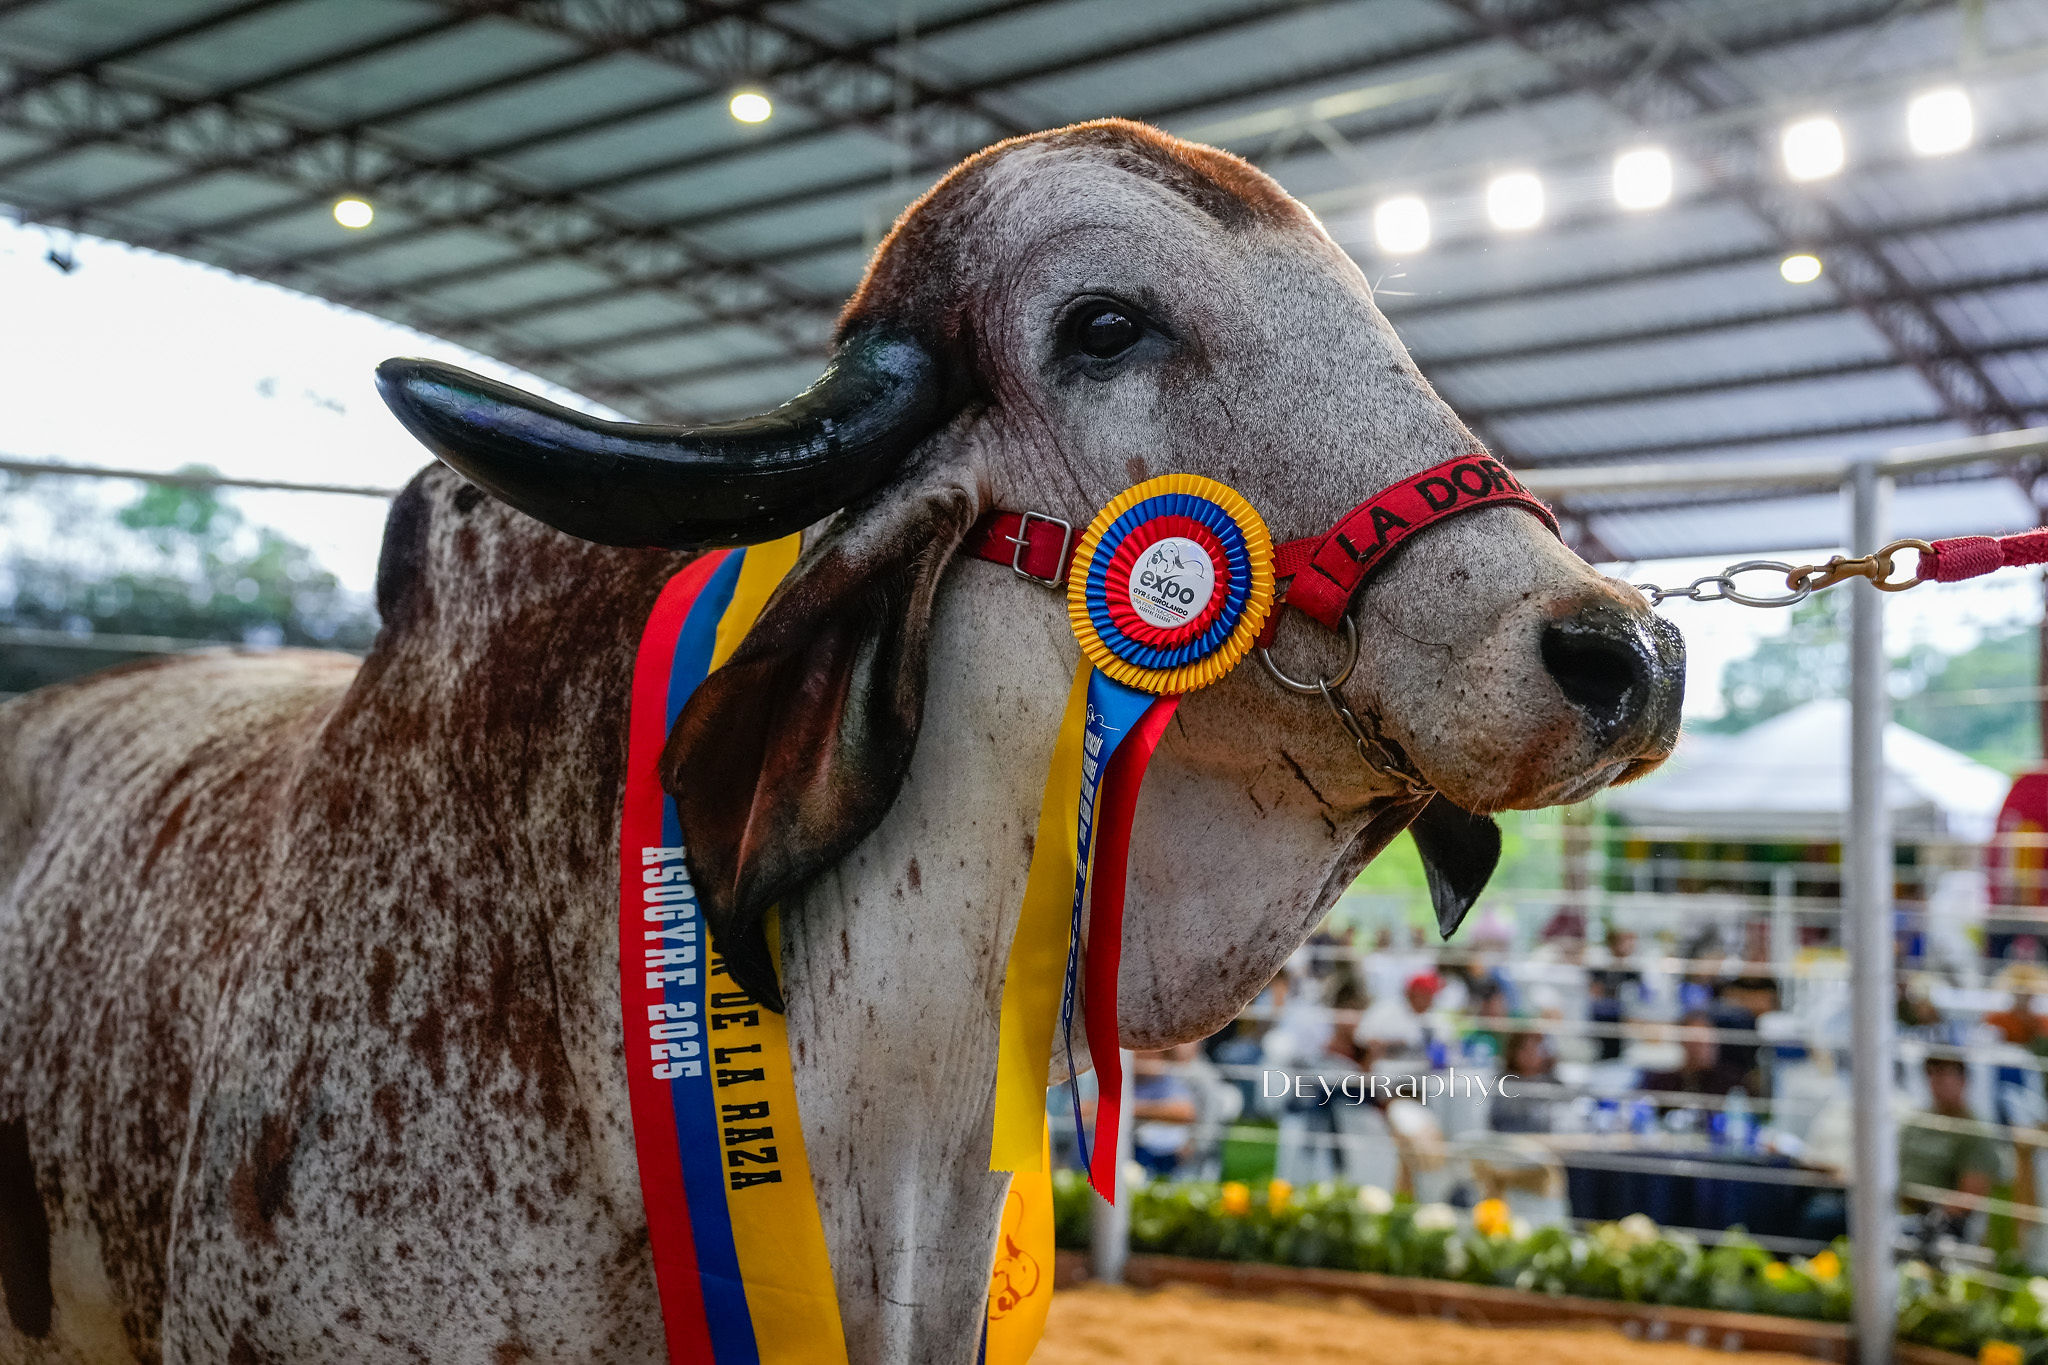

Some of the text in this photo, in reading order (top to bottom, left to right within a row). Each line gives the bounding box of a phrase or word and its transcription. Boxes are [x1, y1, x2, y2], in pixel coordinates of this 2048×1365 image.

[1335, 460, 1524, 565] LA DOR
[1133, 587, 1147, 598] GYR
[1151, 595, 1188, 616] GIROLANDO
[1140, 570, 1195, 605] expo
[642, 846, 703, 1080] ASOGYRE 2025
[710, 991, 783, 1191] DE LA RAZA
